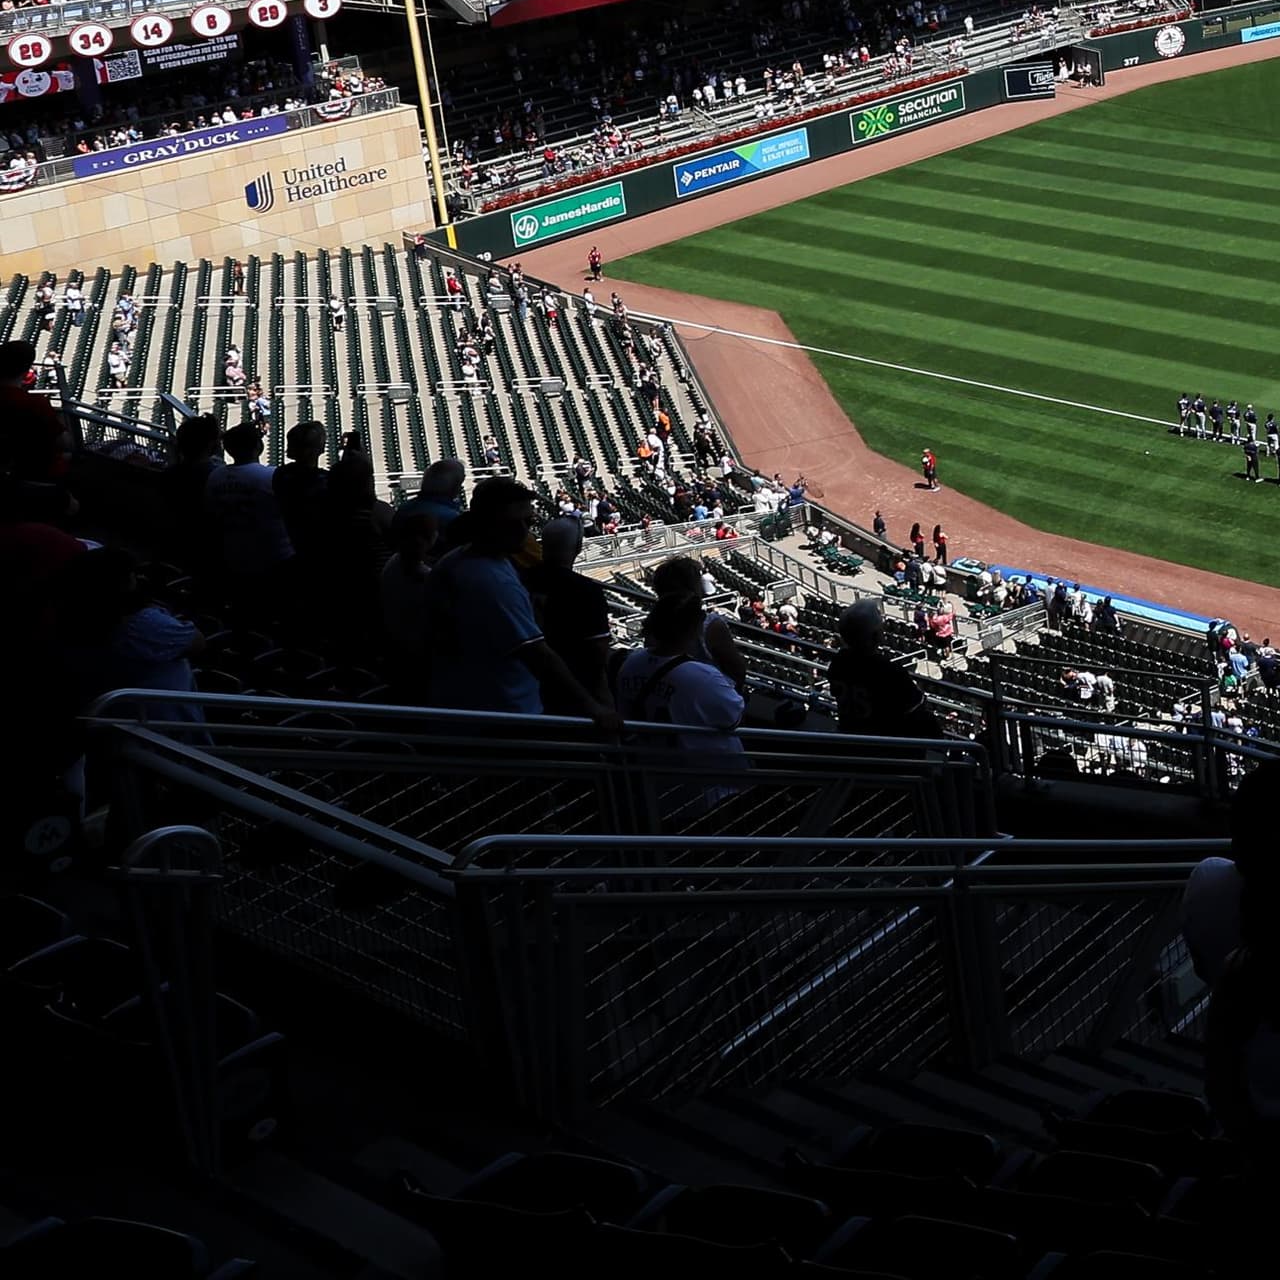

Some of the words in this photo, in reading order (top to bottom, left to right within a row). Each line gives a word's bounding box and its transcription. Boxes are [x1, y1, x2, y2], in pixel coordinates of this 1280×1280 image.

[258, 4, 280, 22] 29
[79, 31, 105, 50] 34
[142, 22, 164, 41] 14
[19, 41, 43, 61] 28
[1122, 55, 1140, 67] 377
[1033, 71, 1055, 85] Twin
[898, 87, 958, 116] securian
[900, 106, 943, 125] FINANCIAL
[123, 143, 181, 165] GRAY
[184, 130, 241, 152] DUCK
[281, 156, 347, 186] United
[694, 159, 741, 181] PENTAIR
[286, 167, 388, 203] Healthcare
[541, 195, 621, 228] JamesHardie
